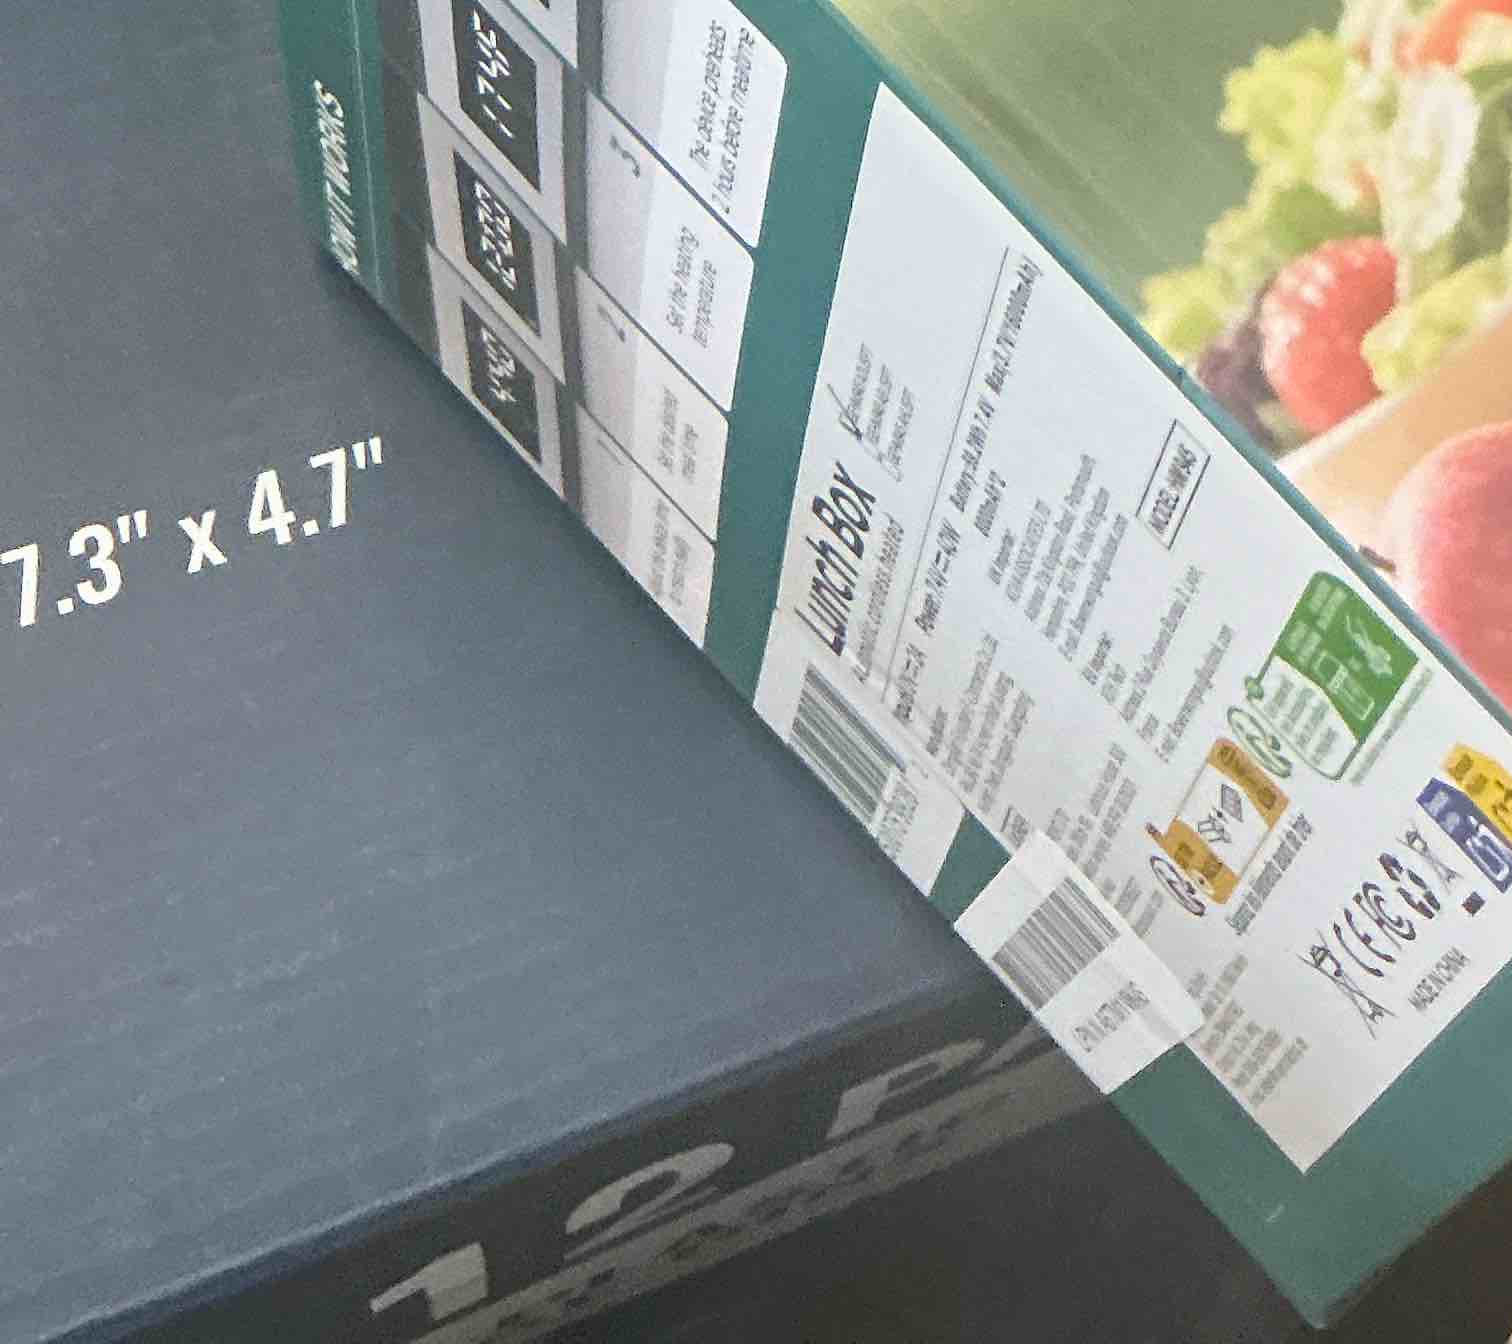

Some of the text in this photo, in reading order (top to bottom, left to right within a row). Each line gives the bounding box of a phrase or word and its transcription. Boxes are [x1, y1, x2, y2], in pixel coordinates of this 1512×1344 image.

[696, 90, 717, 143] device
[608, 138, 641, 180] 3
[671, 225, 700, 285] heating
[669, 281, 688, 310] the
[0, 435, 384, 627] 7.3" x 4.7"
[811, 462, 875, 559] Box
[794, 537, 857, 656] Lunch
